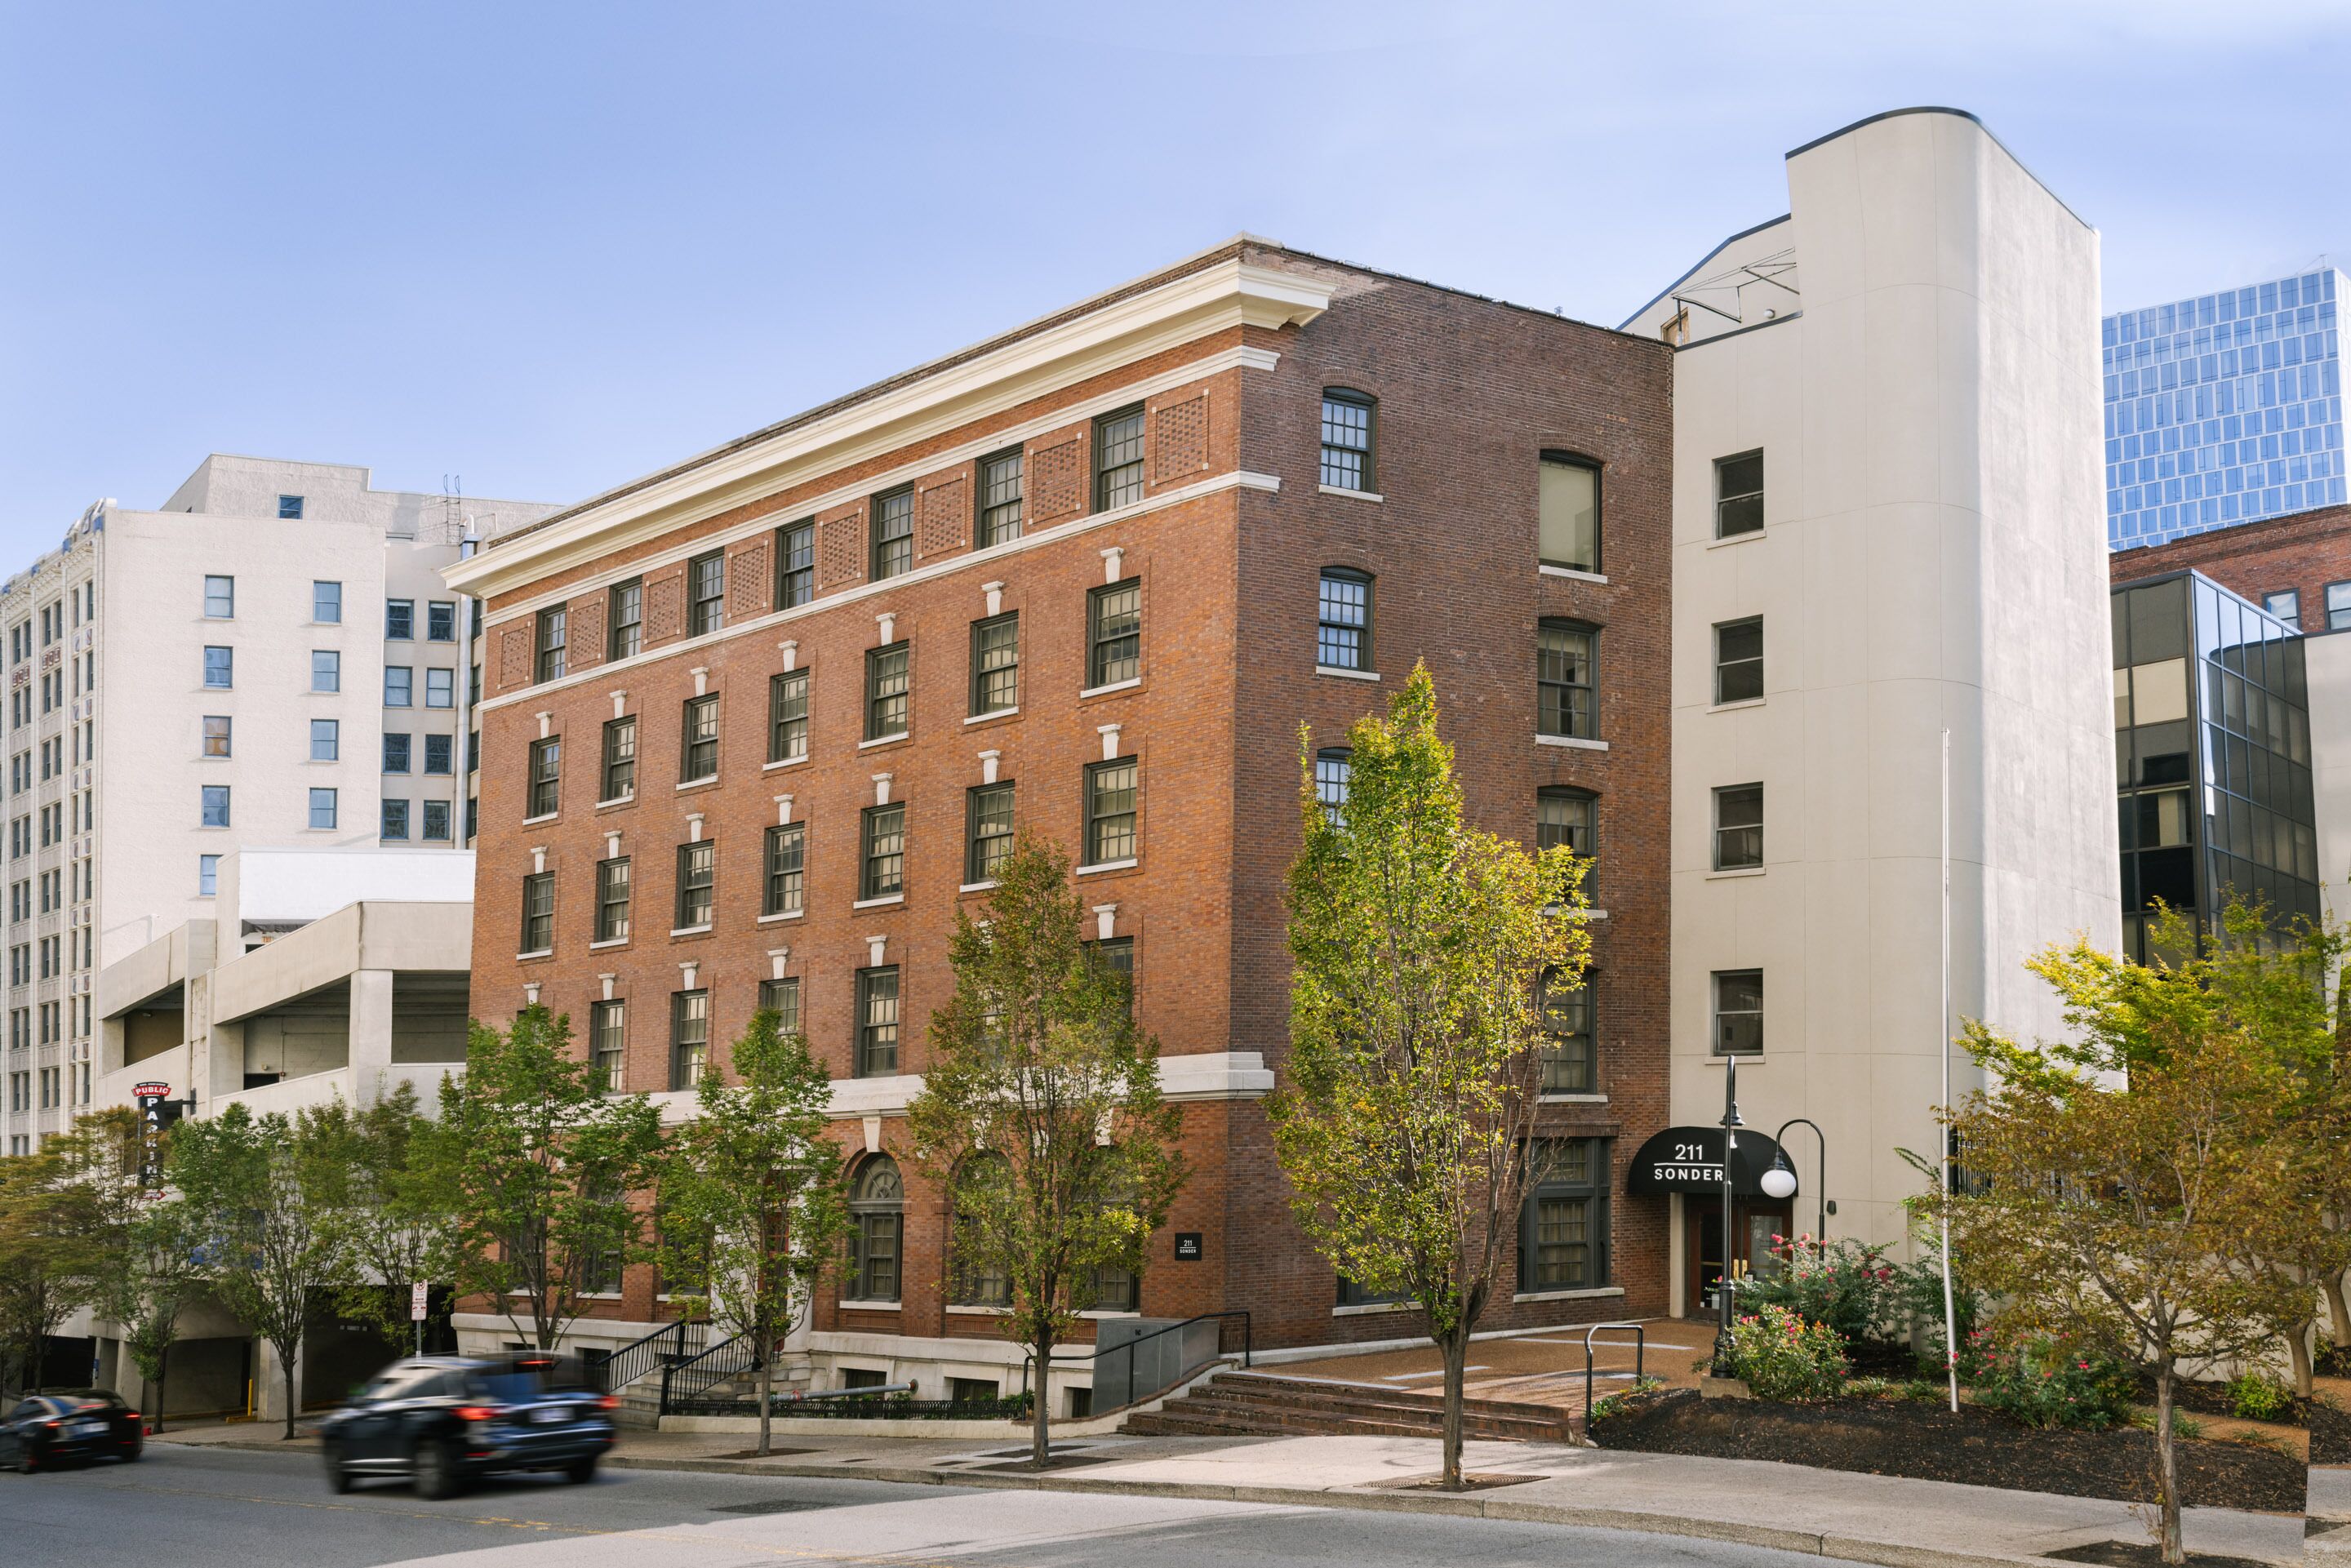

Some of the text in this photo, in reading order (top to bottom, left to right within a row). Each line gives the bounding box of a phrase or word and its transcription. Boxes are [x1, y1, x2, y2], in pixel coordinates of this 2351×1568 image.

[136, 1086, 169, 1095] PUBLIC
[1675, 1144, 1703, 1161] 211
[1654, 1168, 1723, 1181] SONDER
[1184, 1239, 1193, 1247] 211
